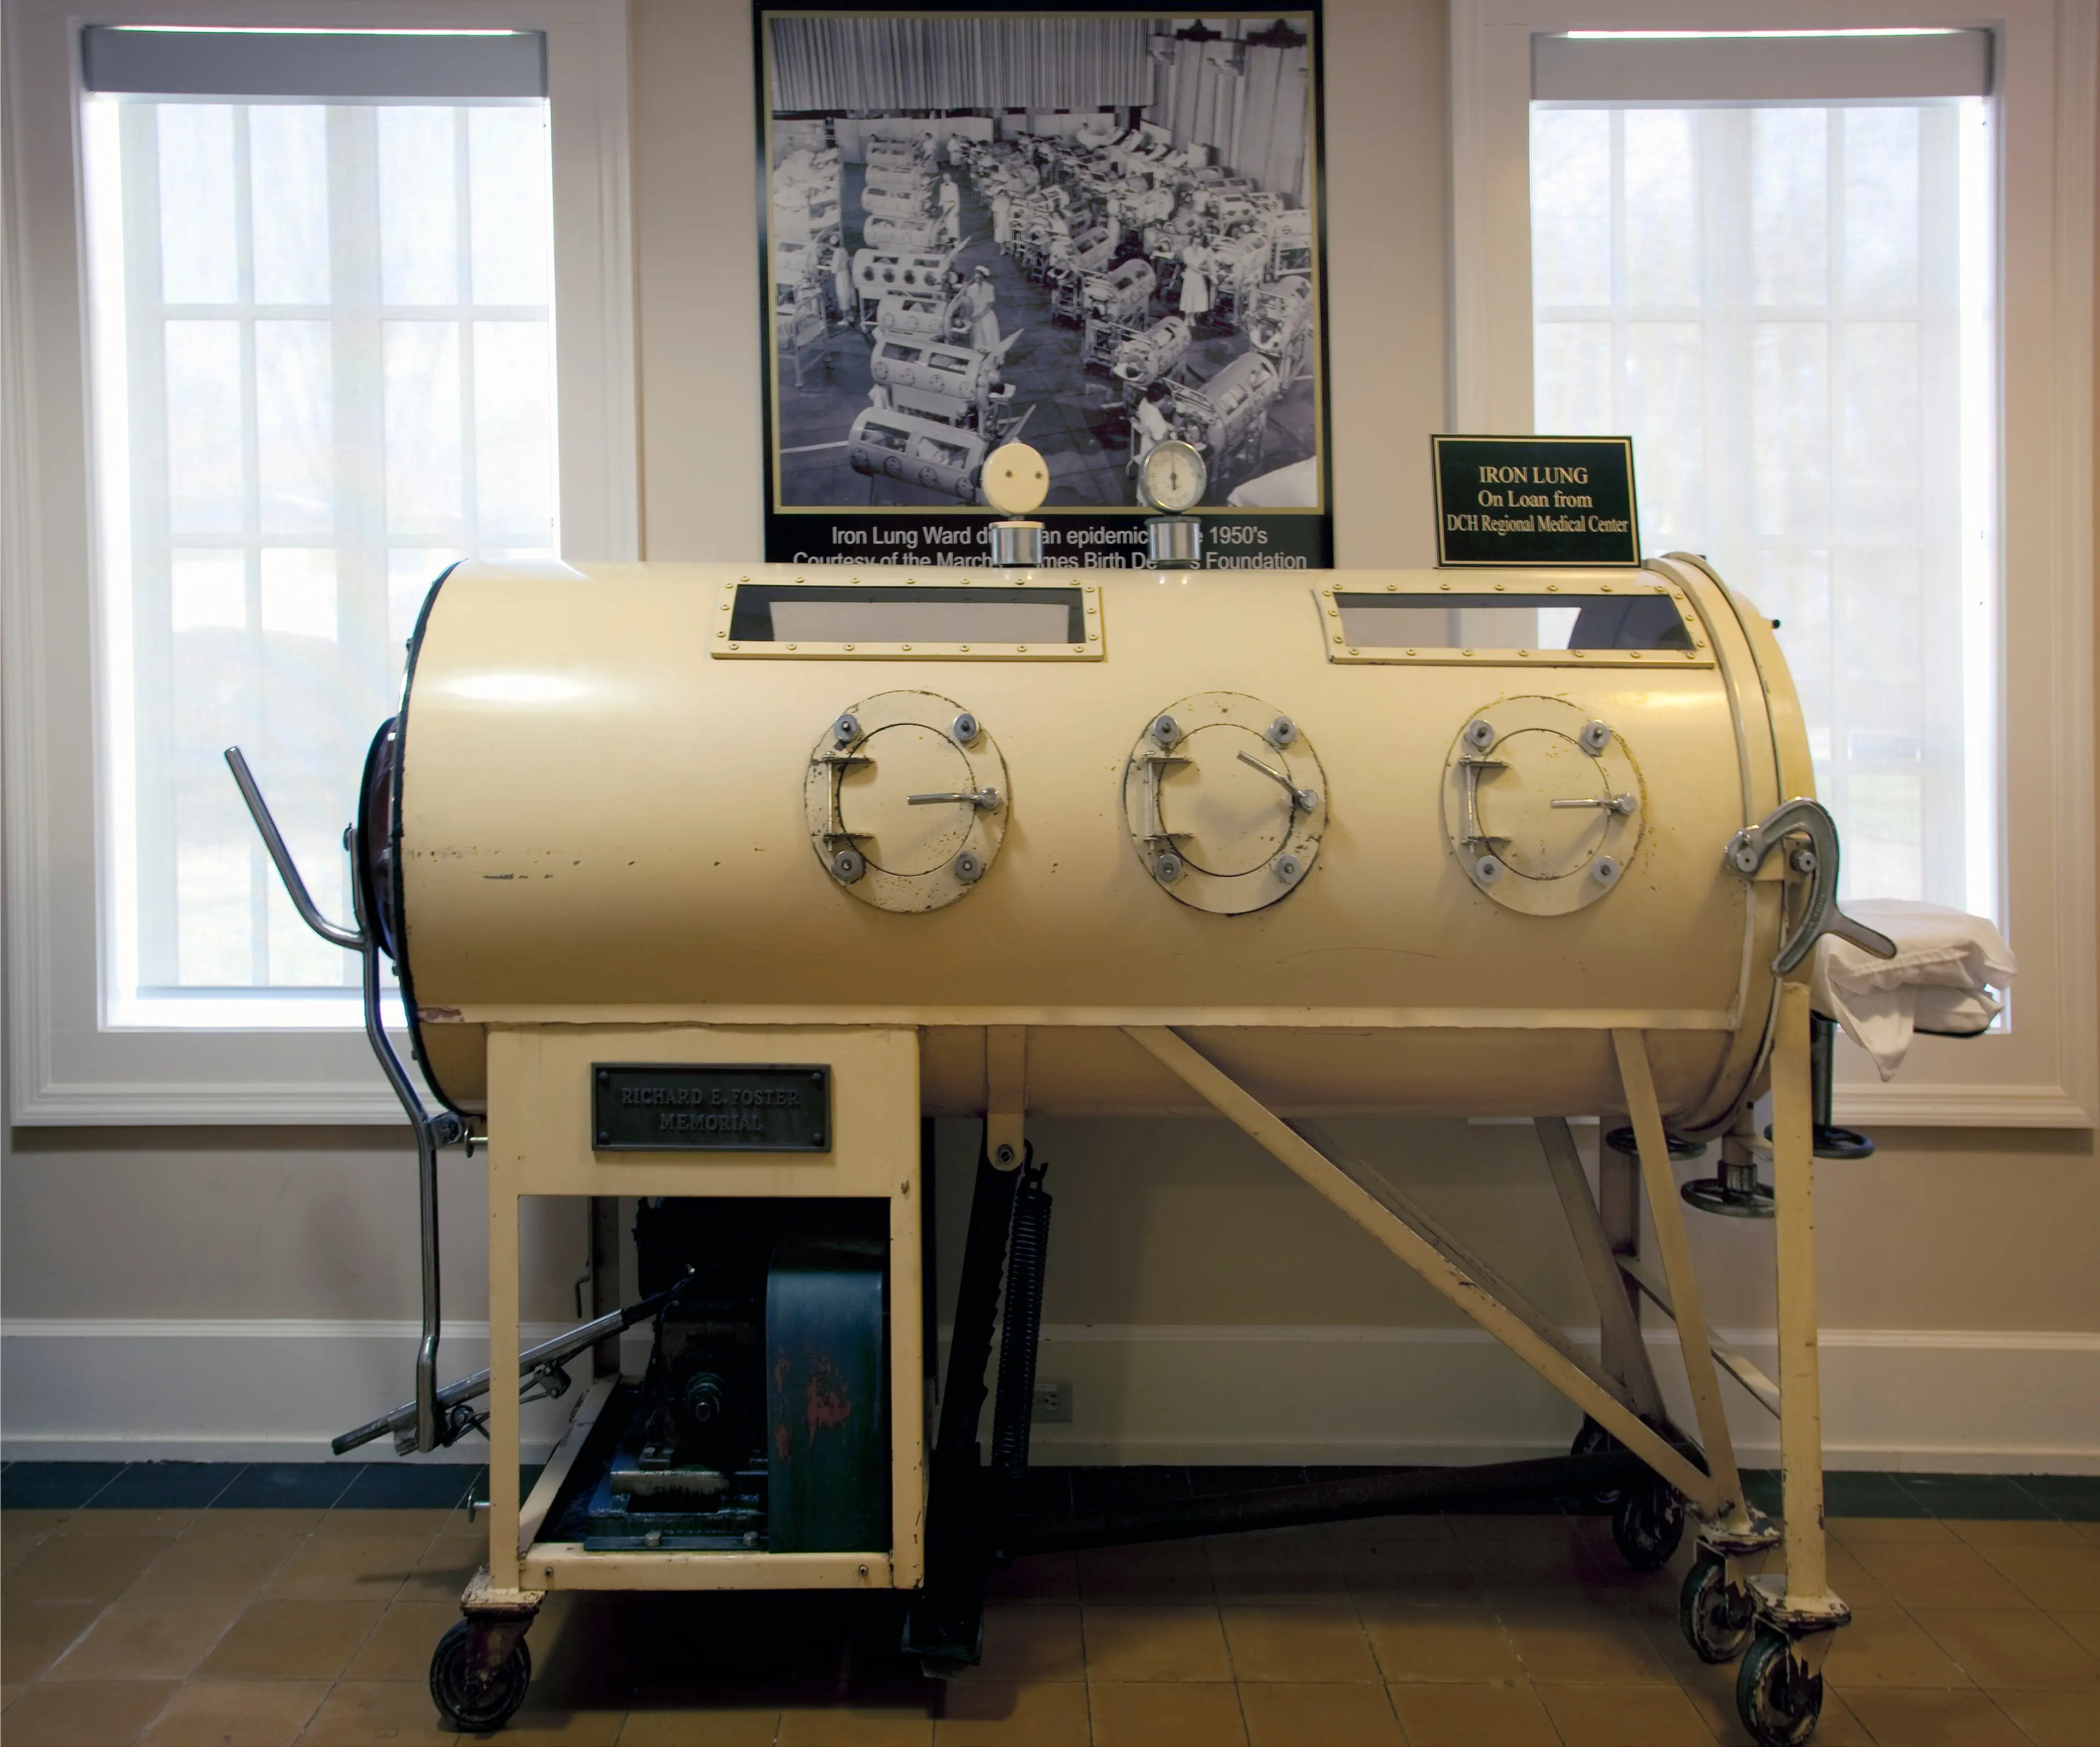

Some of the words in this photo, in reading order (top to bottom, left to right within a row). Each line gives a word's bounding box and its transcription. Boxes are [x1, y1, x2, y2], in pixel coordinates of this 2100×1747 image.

[1478, 466, 1527, 484] IRON
[1533, 467, 1589, 485] LUNG
[1478, 490, 1504, 507] On
[1507, 490, 1550, 508] Loan
[1553, 490, 1594, 508] from
[1446, 514, 1479, 531] DCH
[1481, 514, 1535, 535] Regional
[1537, 514, 1586, 532] Medical
[1588, 516, 1629, 533] Center
[832, 526, 867, 544] Iron
[872, 526, 918, 549] Lung
[922, 526, 971, 544] Ward
[1066, 526, 1149, 549] epidemic
[1209, 526, 1268, 544] 1950's
[879, 552, 899, 565] of
[902, 552, 931, 566] the
[936, 552, 993, 567] March
[1040, 555, 1079, 568] mes
[1084, 551, 1125, 568] Birth
[1206, 551, 1307, 569] Foundation
[622, 1087, 702, 1105] RICHARD
[711, 1088, 729, 1105] E.
[731, 1088, 800, 1106] FOSTER
[660, 1114, 763, 1132] MEMORIAL
